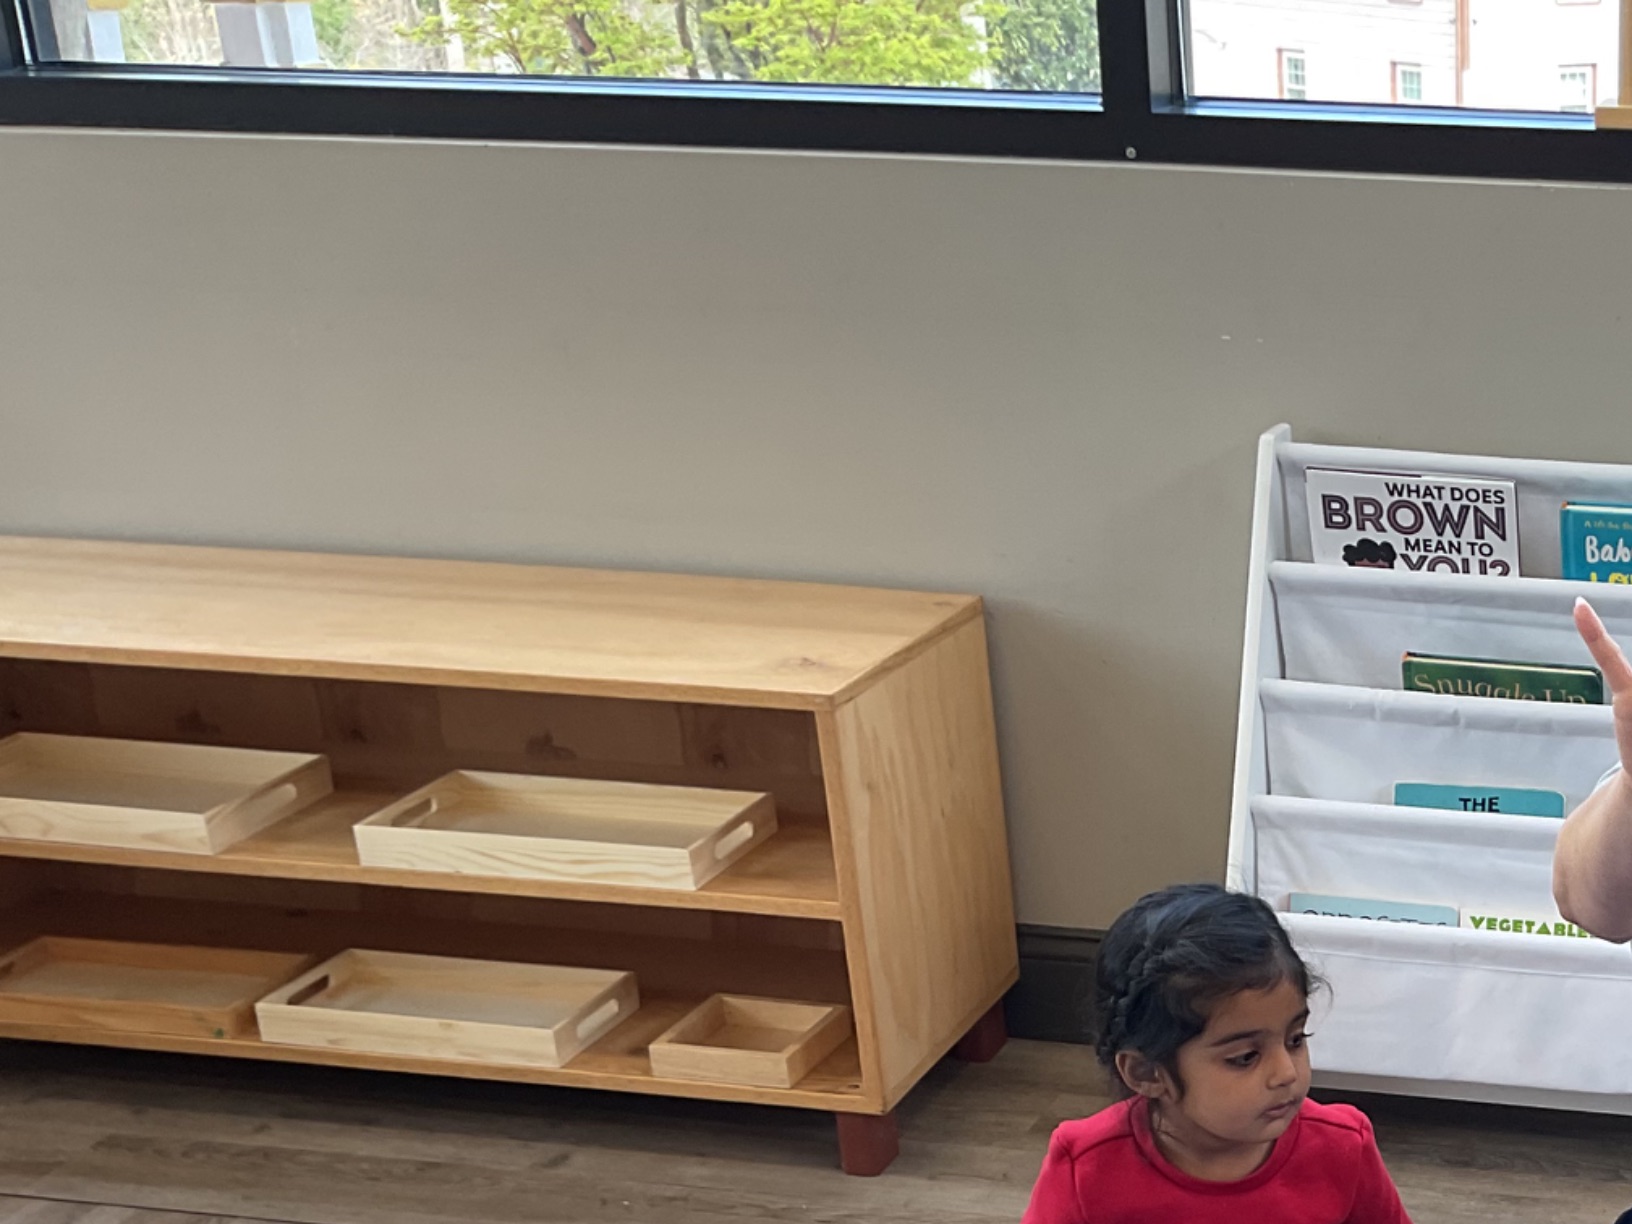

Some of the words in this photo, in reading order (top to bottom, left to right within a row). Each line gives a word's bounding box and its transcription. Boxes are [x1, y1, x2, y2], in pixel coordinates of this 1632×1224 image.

[1385, 482, 1445, 501] WHAT
[1450, 487, 1505, 504] DOES
[1321, 493, 1507, 541] BROWN
[1404, 538, 1461, 555] MEAN
[1467, 541, 1494, 557] TO
[1458, 796, 1500, 813] THE
[1470, 915, 1597, 938] VEGETABLE
